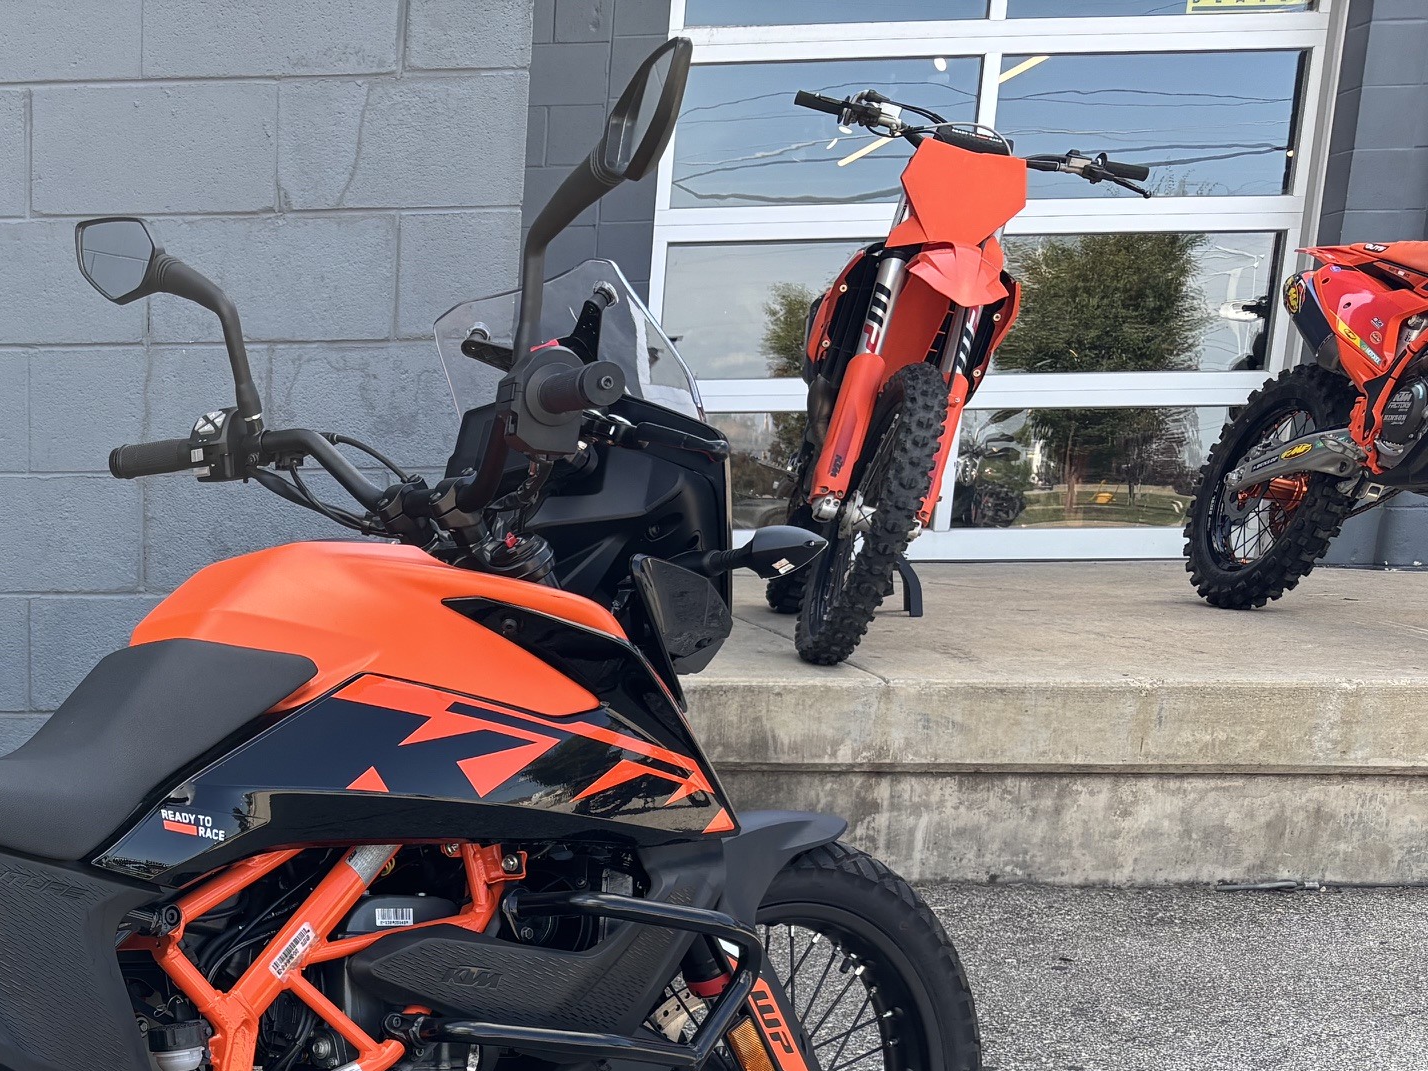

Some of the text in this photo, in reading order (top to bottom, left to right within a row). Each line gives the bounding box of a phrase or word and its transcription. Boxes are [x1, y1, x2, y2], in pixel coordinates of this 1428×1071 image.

[161, 809, 212, 827] READY TO
[198, 827, 225, 841] RACE
[441, 965, 503, 990] KTM
[751, 990, 794, 1054] WP
